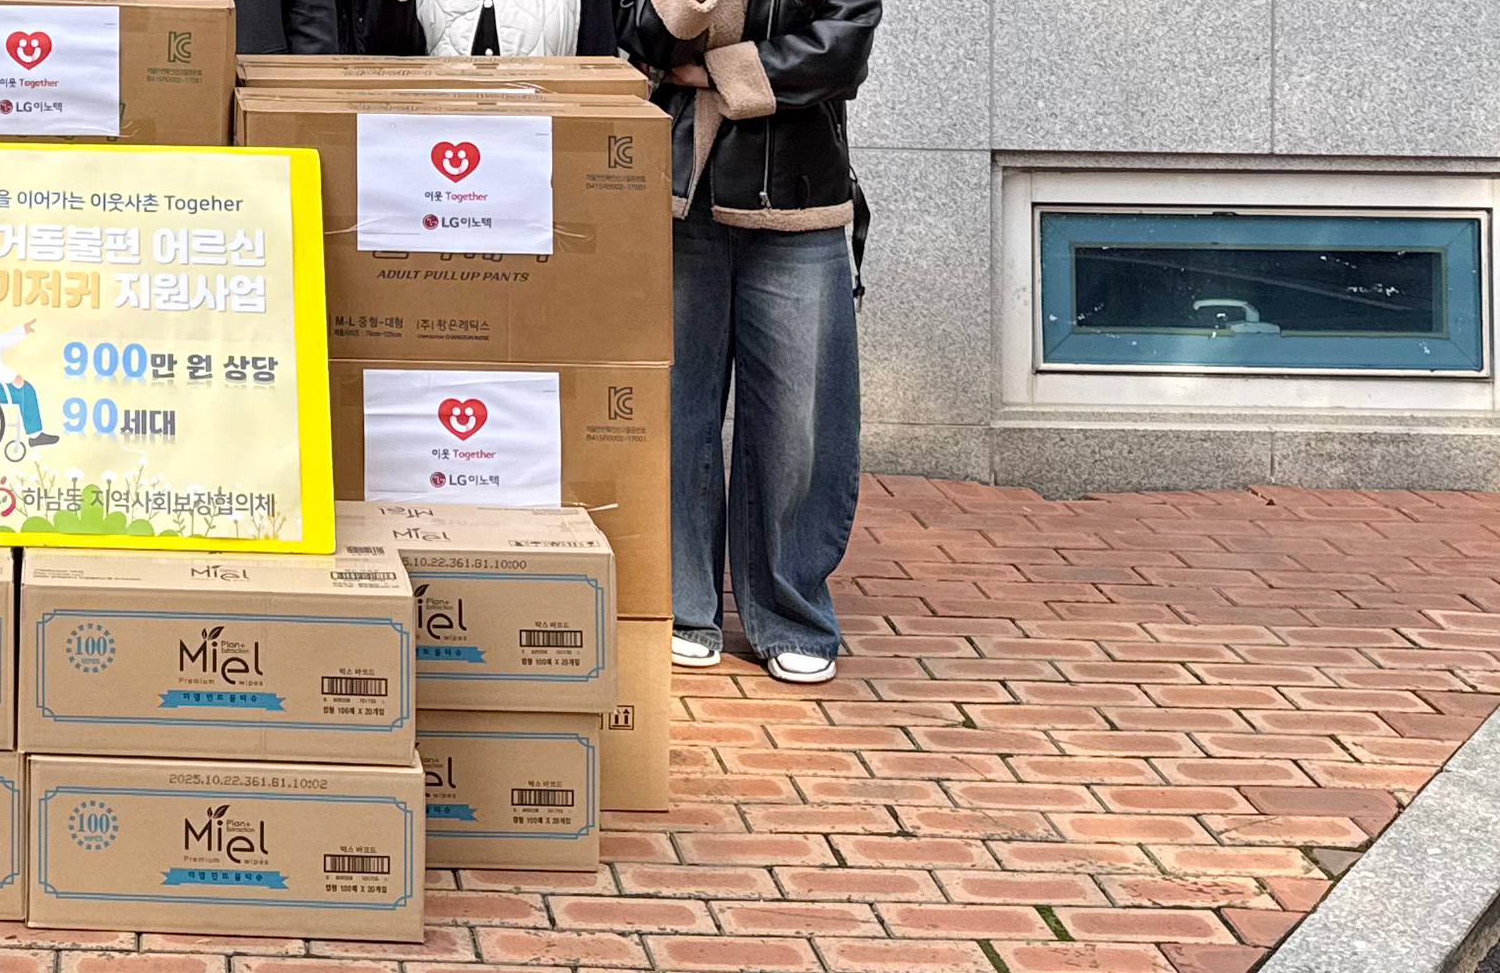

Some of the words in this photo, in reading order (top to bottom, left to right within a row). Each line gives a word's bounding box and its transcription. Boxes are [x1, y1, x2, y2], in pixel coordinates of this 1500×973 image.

[0, 77, 17, 89] 이웃
[19, 78, 59, 89] Together
[17, 190, 85, 211] 이어가는
[90, 193, 159, 213] 이웃사촌
[163, 195, 243, 215] Togeher
[424, 191, 443, 202] 이웃
[445, 192, 488, 203] Together
[153, 228, 266, 267] 어르신
[376, 269, 421, 279] ADULT
[482, 271, 530, 282] PANTS
[113, 273, 267, 313] 지원사업
[335, 316, 355, 326] M-L
[359, 316, 404, 328] 중형-대형
[63, 341, 177, 379] 900만
[187, 354, 213, 380] 원
[223, 355, 279, 383] 상당
[62, 397, 176, 436] 90세대
[431, 448, 450, 460] 이웃
[453, 449, 496, 461] Together
[23, 487, 82, 512] 하남동
[91, 487, 276, 516] 지역사회보장협의체
[417, 598, 467, 639] iel
[74, 636, 109, 657] 100
[180, 639, 264, 685] Miel
[179, 677, 215, 685] Premium
[76, 814, 110, 833] 100
[185, 818, 268, 864] Miel
